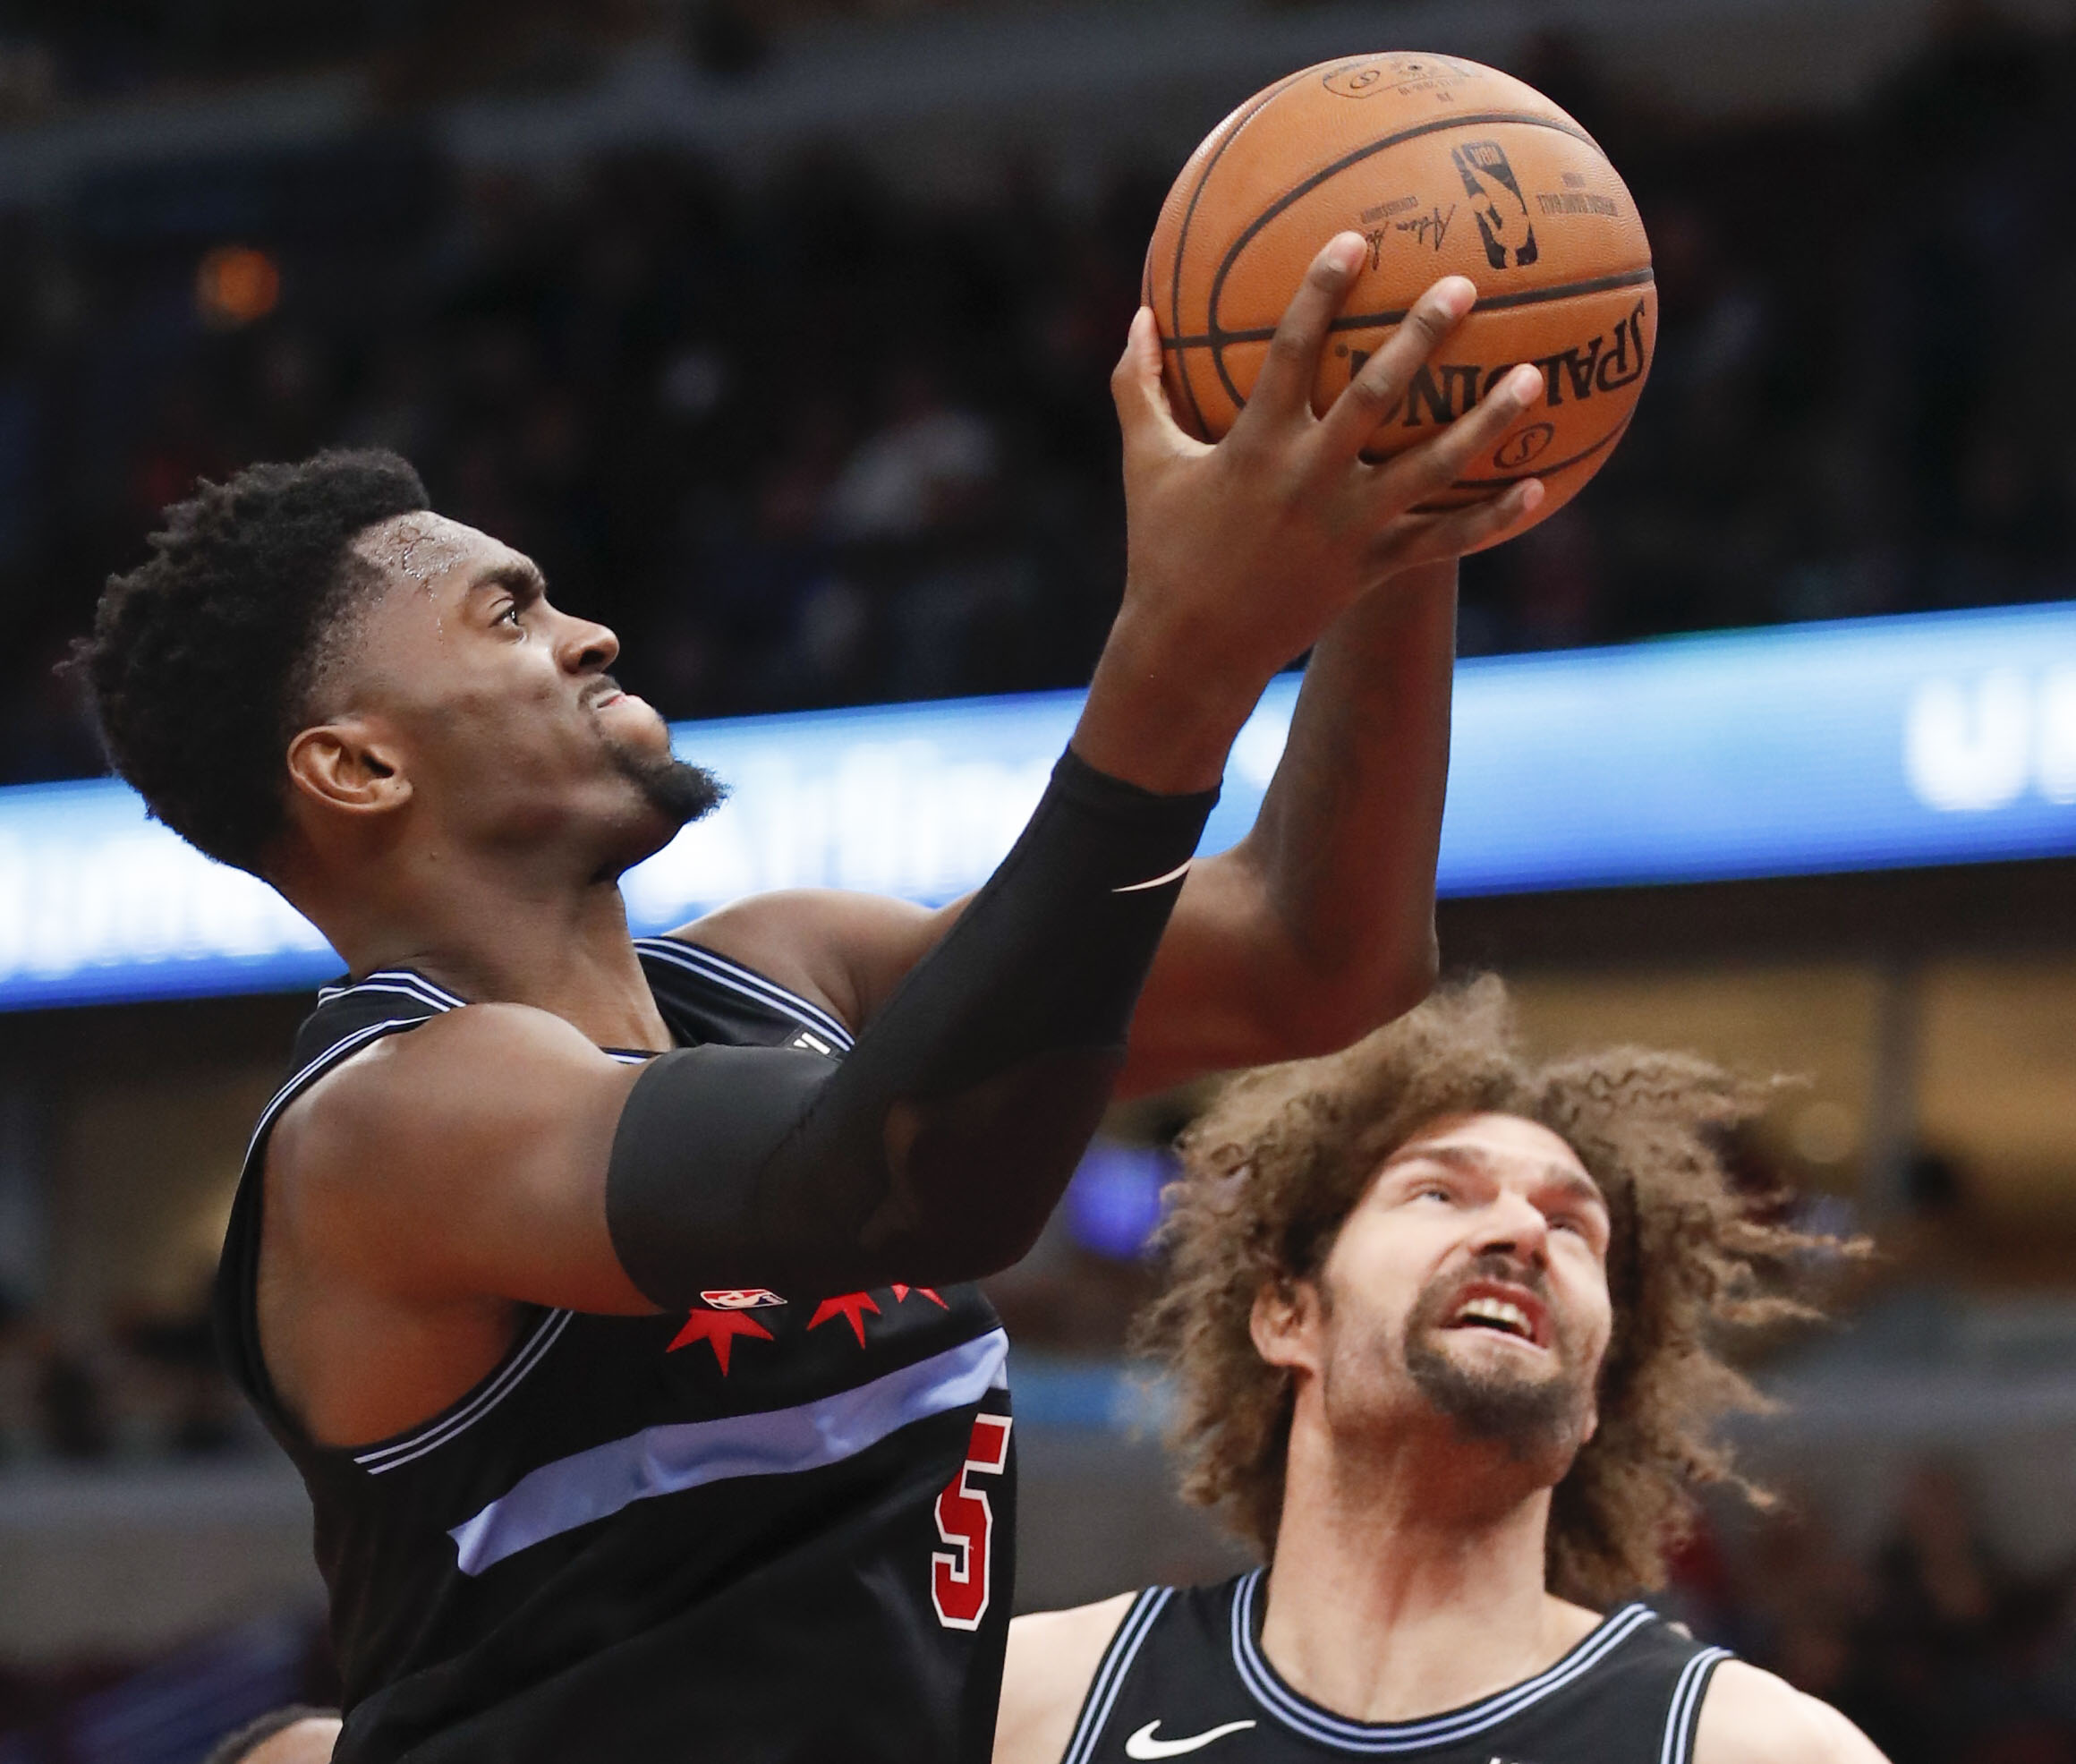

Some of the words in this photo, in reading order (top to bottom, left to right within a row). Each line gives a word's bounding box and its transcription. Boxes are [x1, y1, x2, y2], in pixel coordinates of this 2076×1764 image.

[1469, 145, 1502, 166] NBA
[1349, 297, 1646, 427] SPALIN
[932, 1412, 1013, 1632] 5
